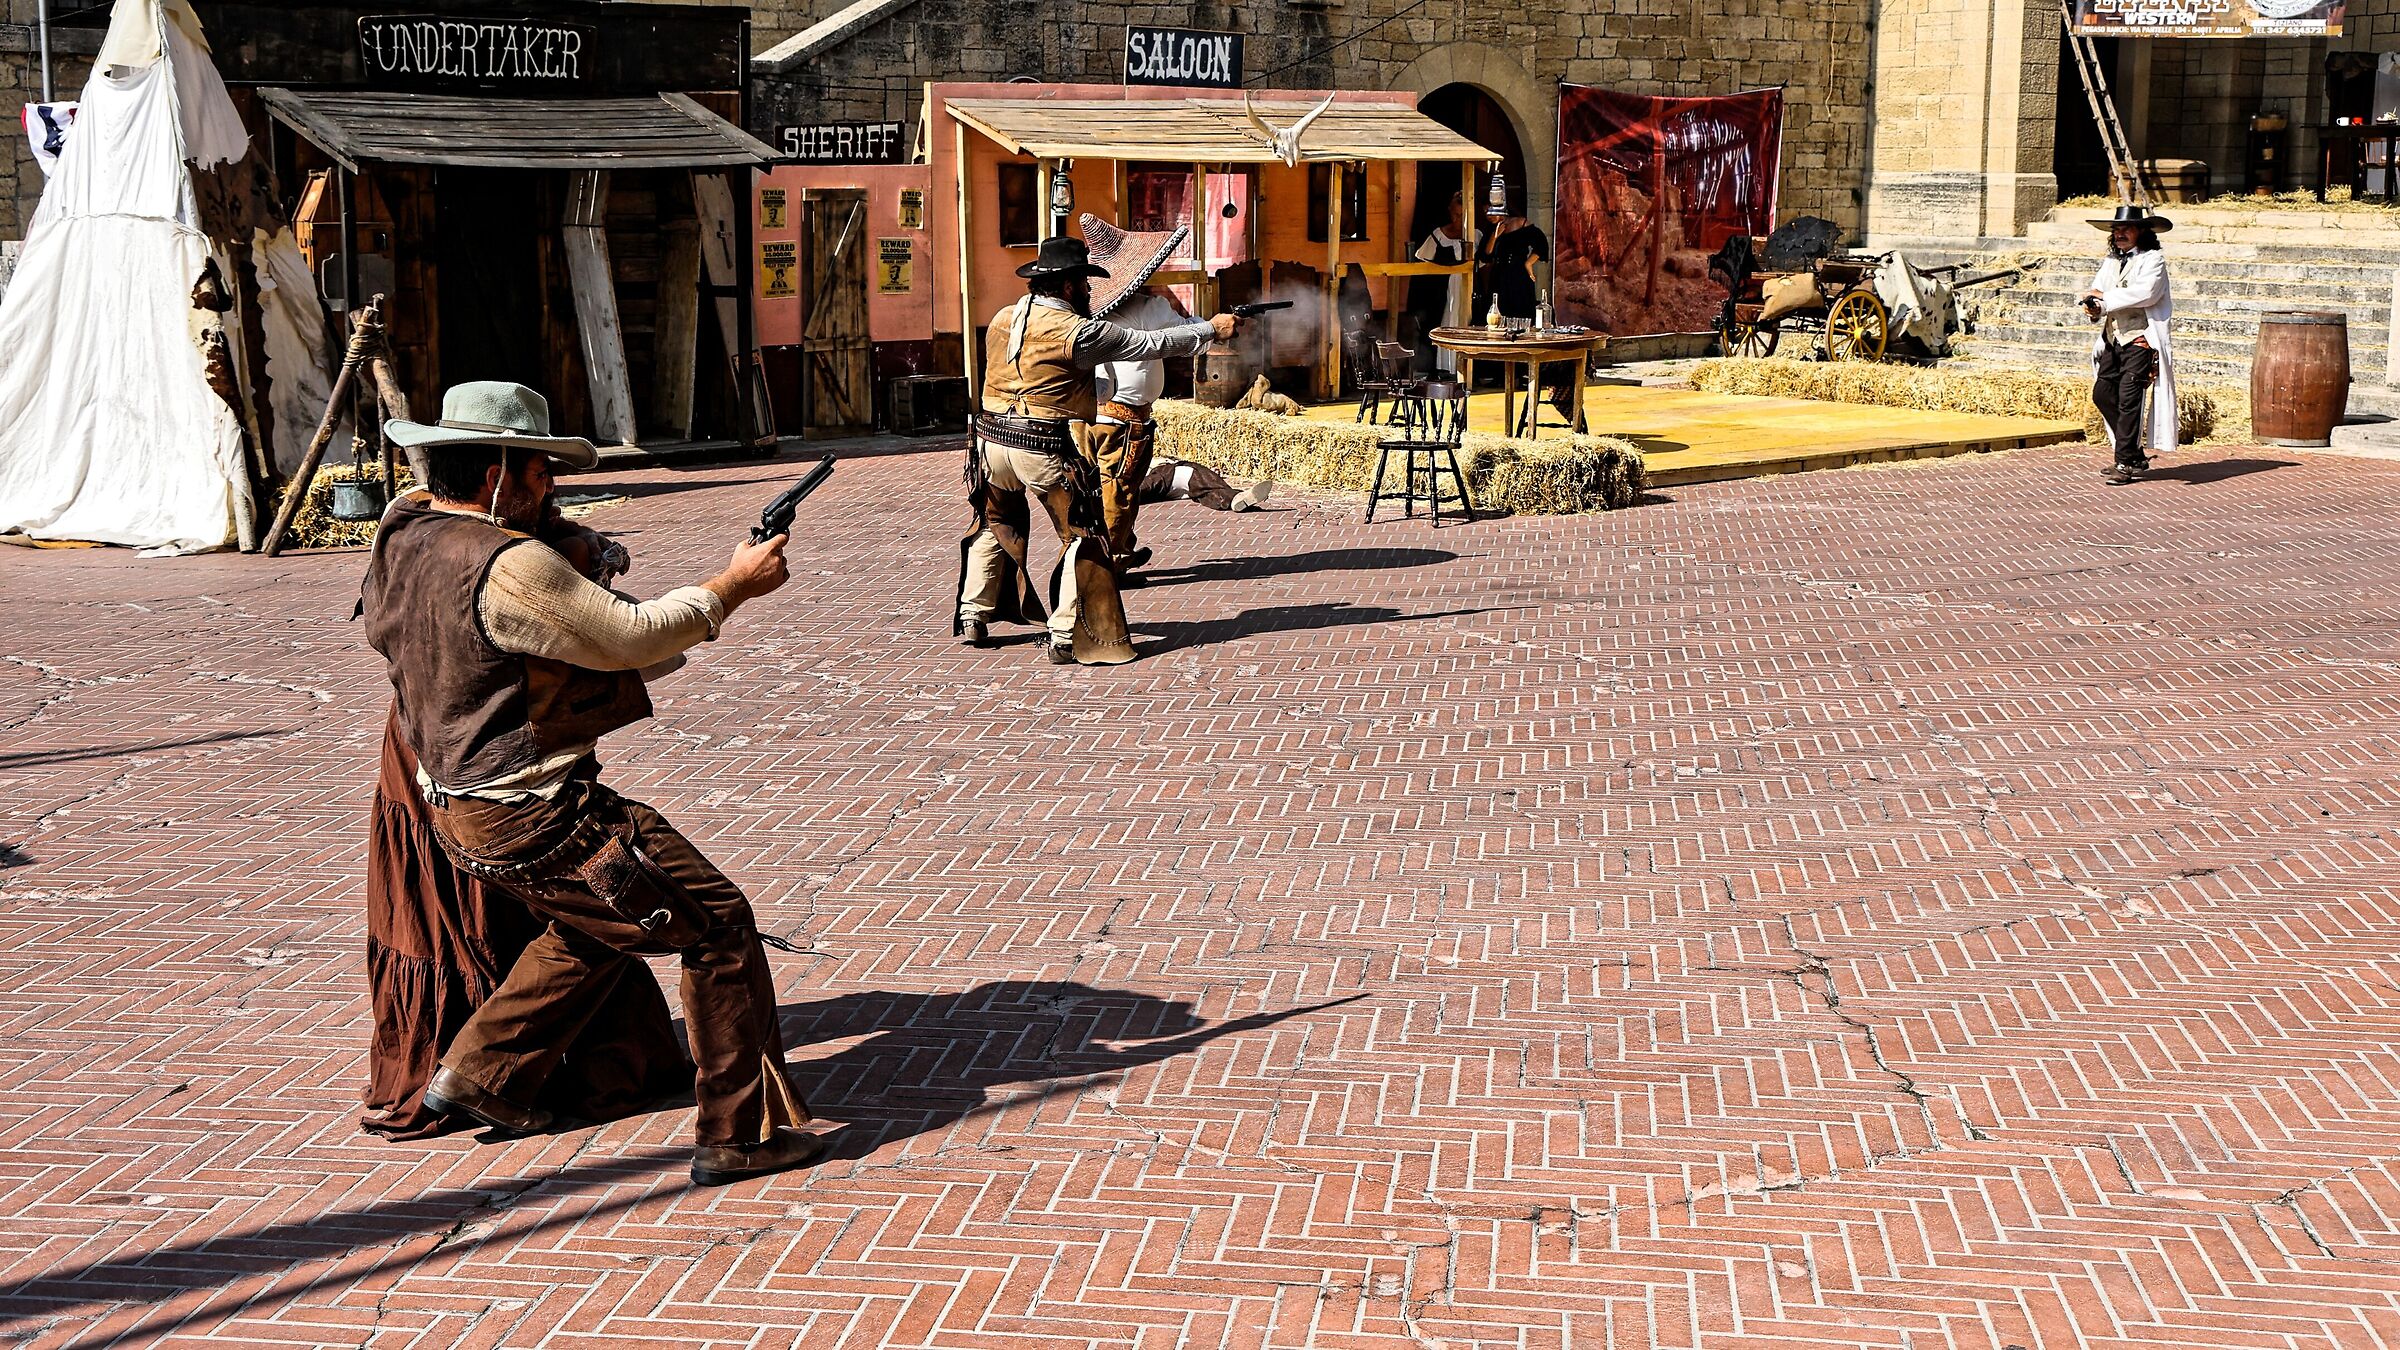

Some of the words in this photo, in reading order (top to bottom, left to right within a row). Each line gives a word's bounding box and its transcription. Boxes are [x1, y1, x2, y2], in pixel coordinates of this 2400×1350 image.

[2124, 12, 2198, 25] WESTERN
[2253, 26, 2266, 34] TEL
[2267, 26, 2285, 34] 347
[371, 21, 581, 79] UNDERTAKER
[1129, 32, 1232, 82] SALOON
[784, 123, 898, 159] SHERIFF
[763, 244, 795, 252] REWARD
[881, 240, 911, 248] REWARD
